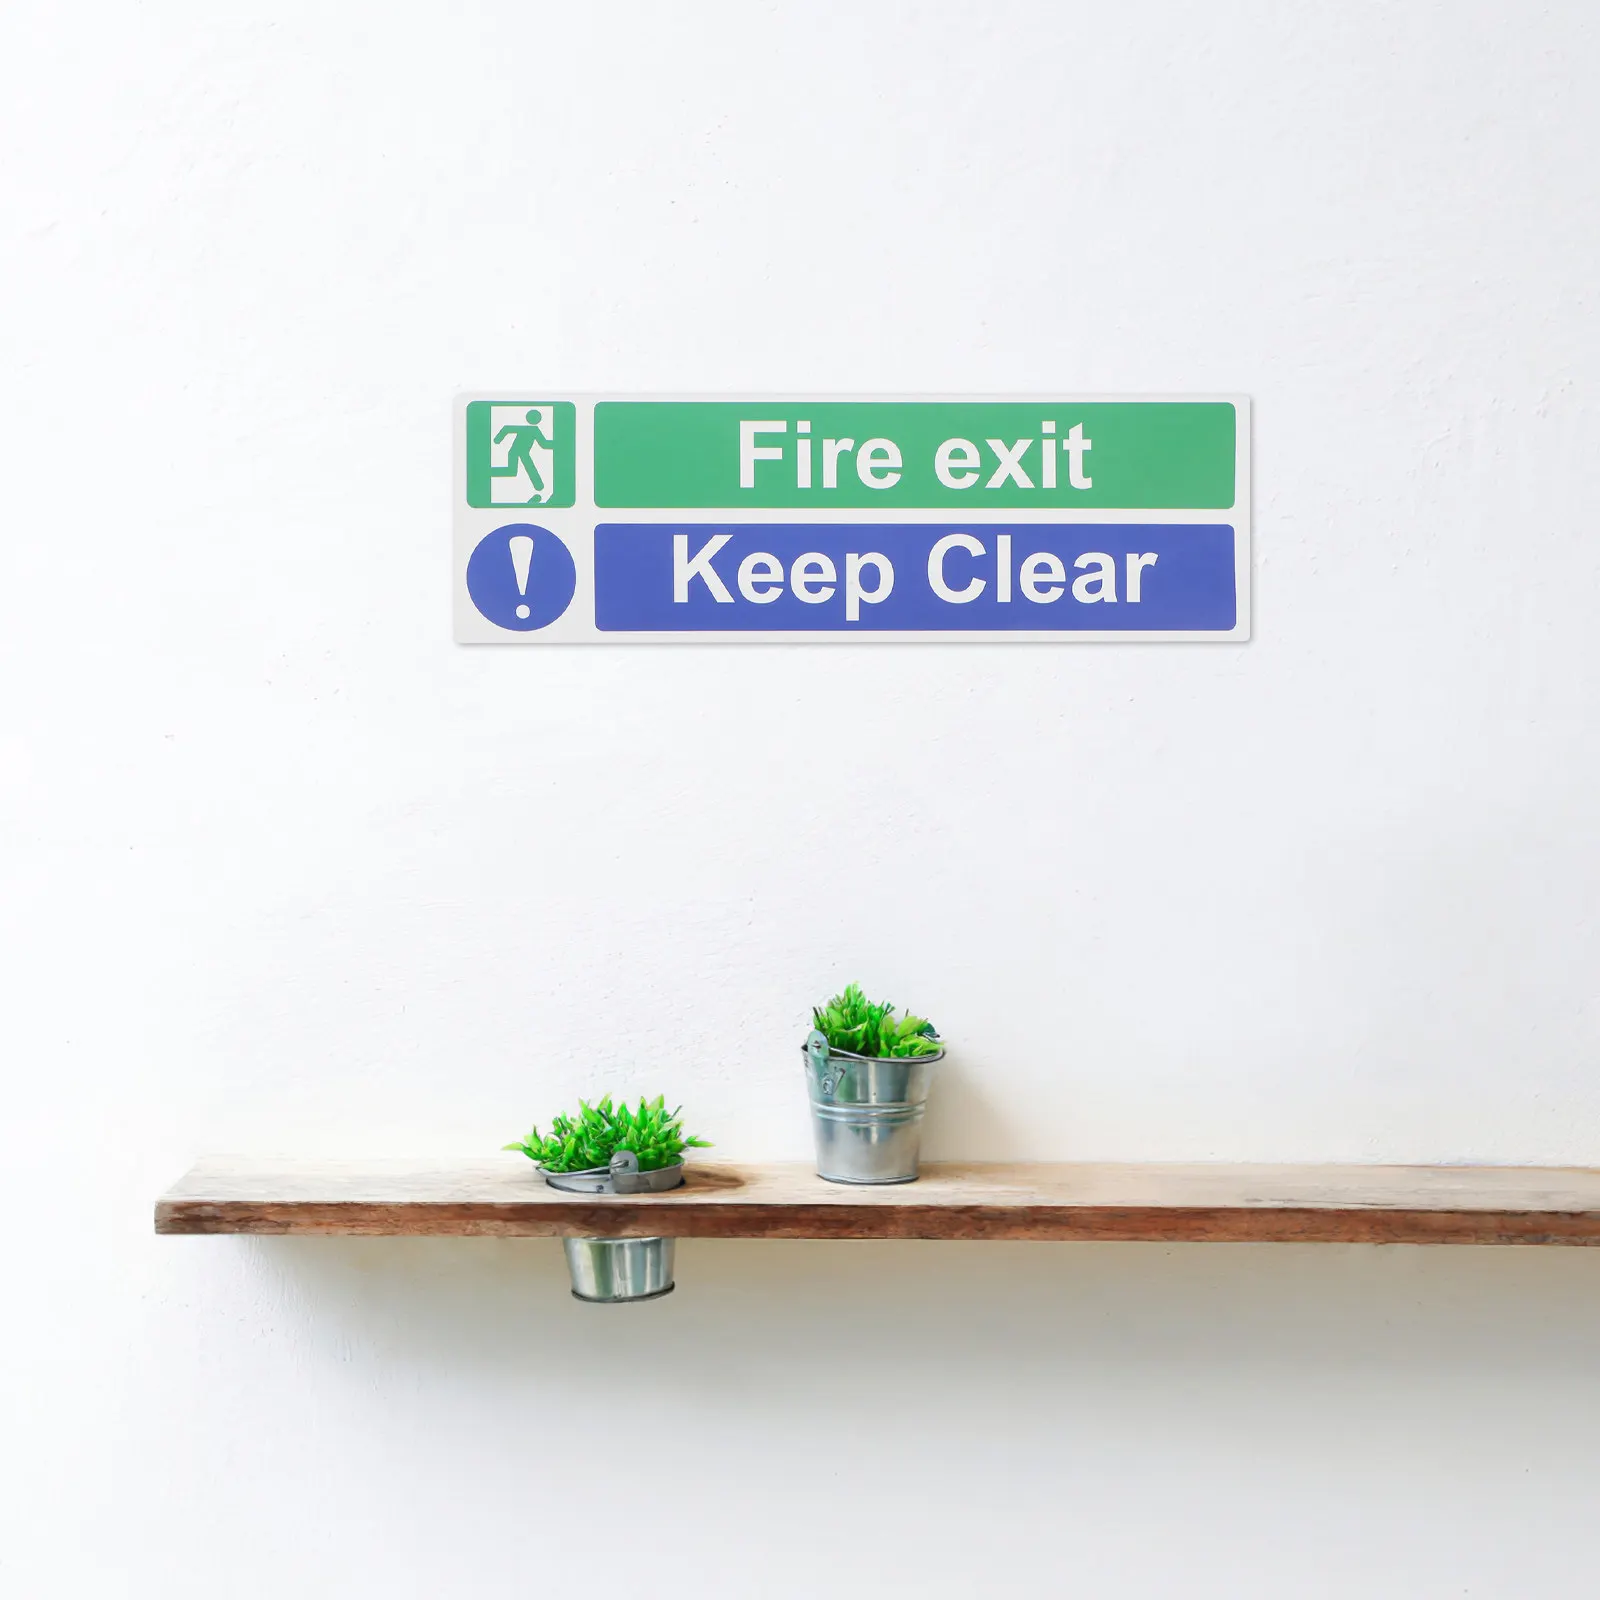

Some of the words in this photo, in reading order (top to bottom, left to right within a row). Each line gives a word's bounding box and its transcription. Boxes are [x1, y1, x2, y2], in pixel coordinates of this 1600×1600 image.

[738, 419, 904, 490] Fire
[933, 420, 1093, 491] exit
[672, 533, 895, 622] Keep
[927, 532, 1159, 605] Clear
